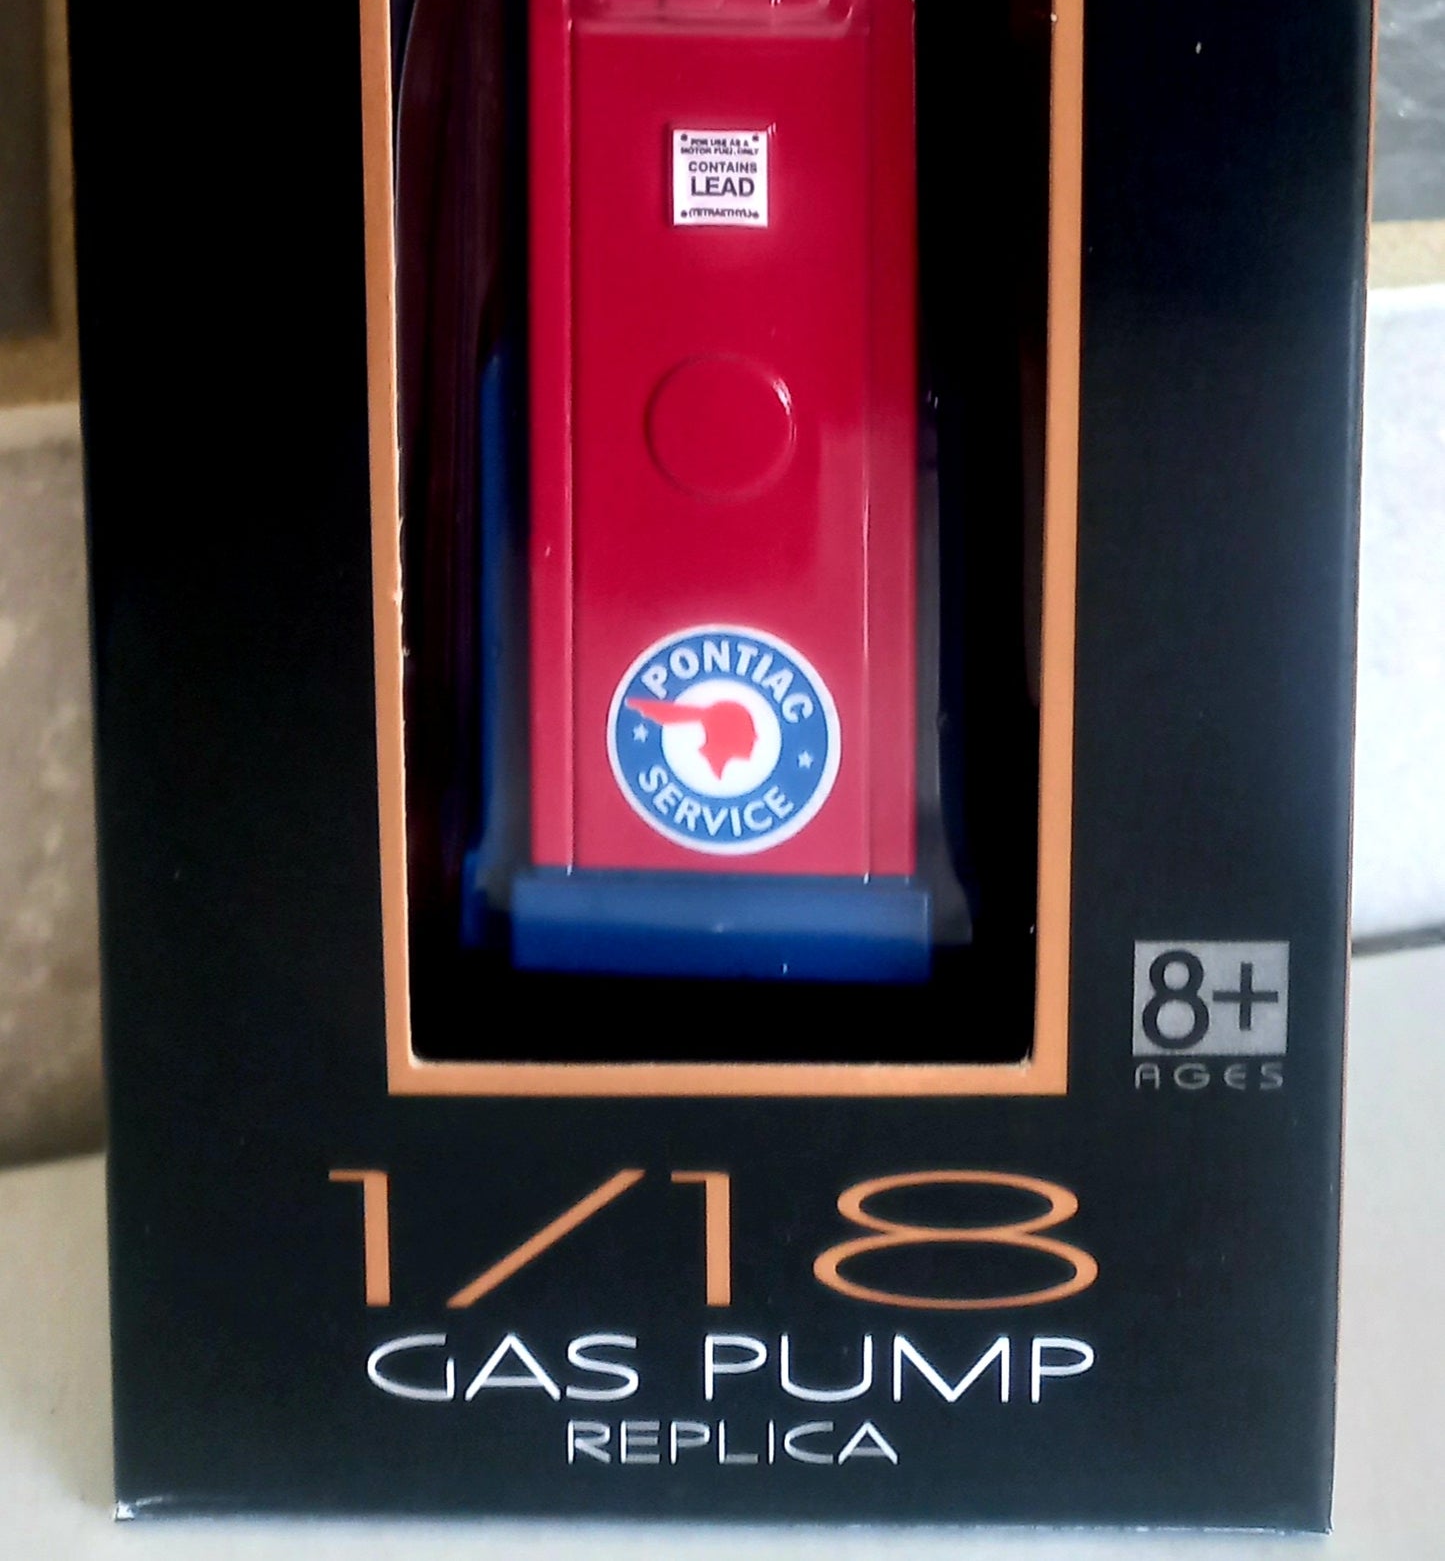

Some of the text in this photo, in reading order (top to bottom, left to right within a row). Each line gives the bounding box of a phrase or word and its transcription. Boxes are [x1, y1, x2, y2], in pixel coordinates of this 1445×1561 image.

[688, 161, 757, 173] CONTAINS
[691, 176, 755, 197] LEAD
[641, 640, 814, 724] PONTIAC
[638, 765, 794, 837] SERVICE
[1142, 950, 1279, 1050] 8+
[1134, 1062, 1284, 1090] AGES
[328, 1168, 1099, 1310] 1/18
[366, 1333, 1095, 1404] GAS PUMP
[567, 1420, 899, 1465] REPLICA
